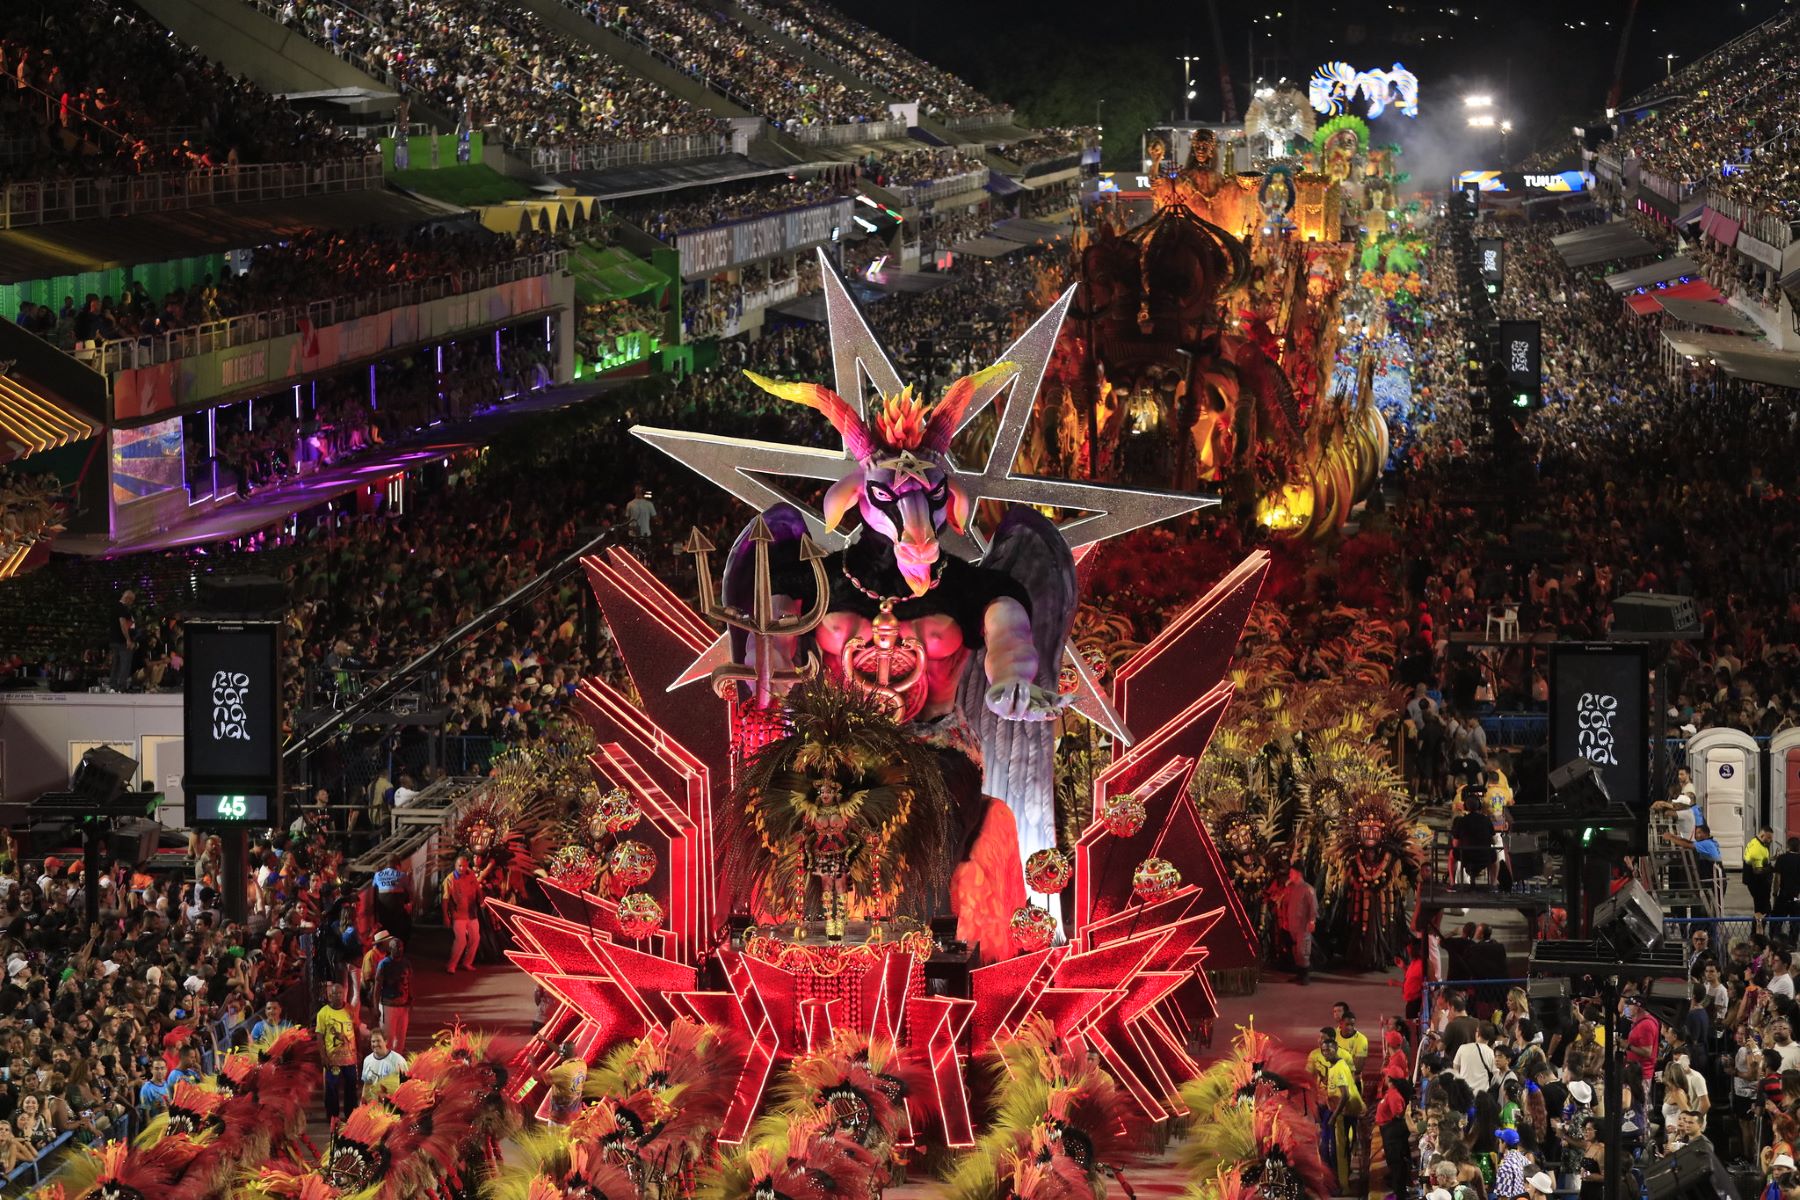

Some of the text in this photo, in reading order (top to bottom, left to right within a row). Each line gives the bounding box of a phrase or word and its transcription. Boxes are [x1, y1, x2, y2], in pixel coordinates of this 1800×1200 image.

[212, 670, 250, 689] RIO
[1577, 692, 1618, 712] RIO
[217, 795, 247, 817] 45
